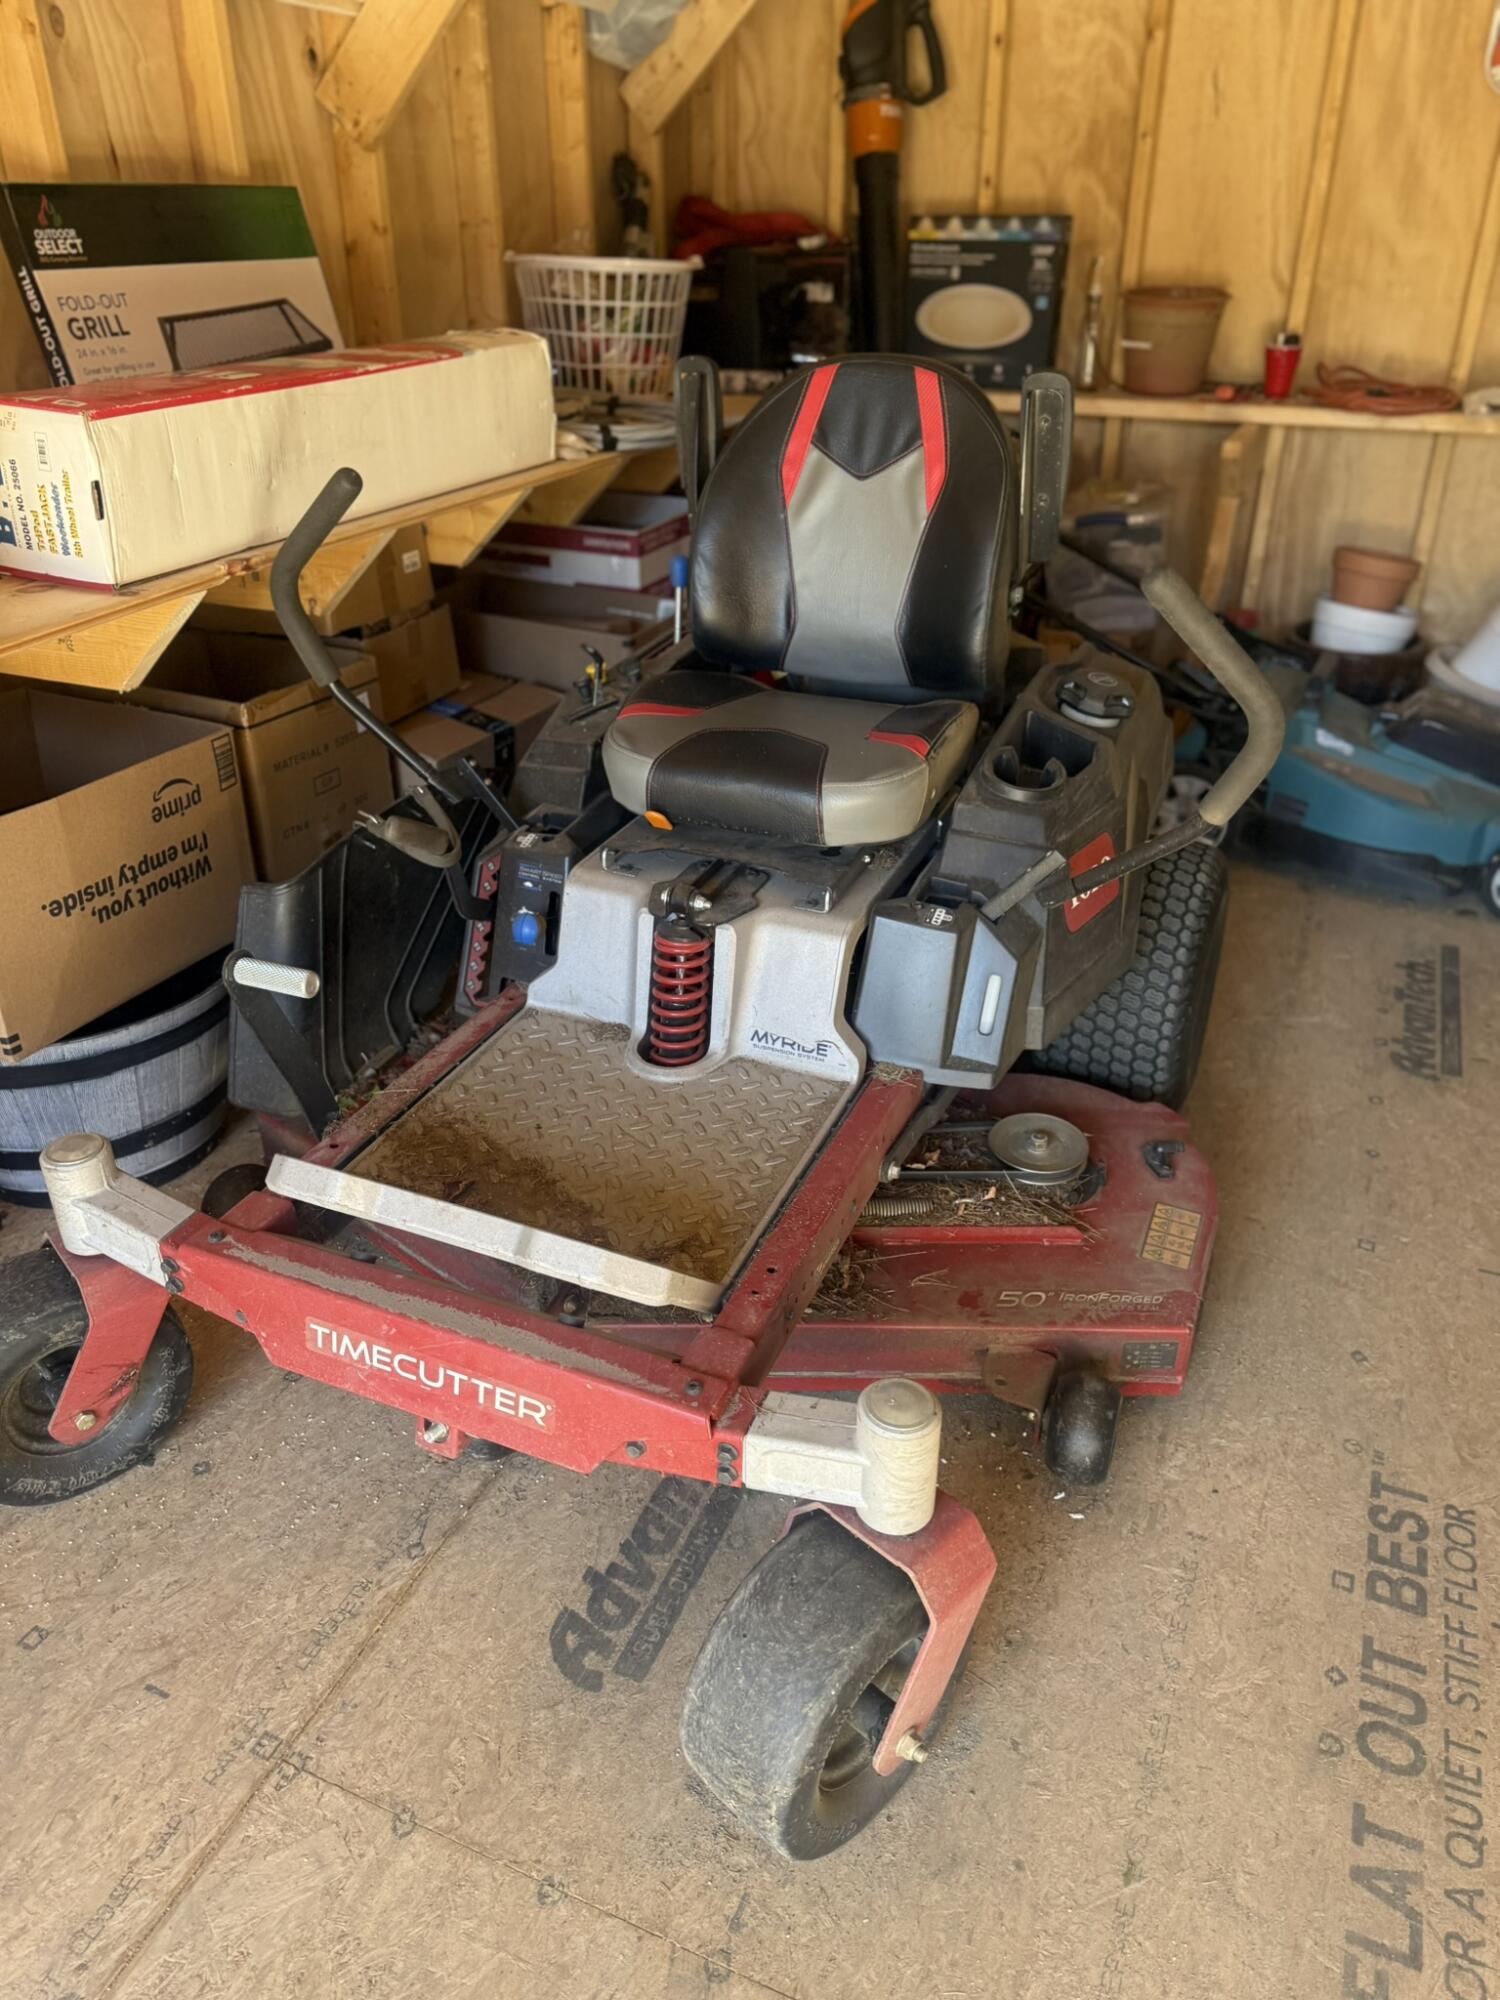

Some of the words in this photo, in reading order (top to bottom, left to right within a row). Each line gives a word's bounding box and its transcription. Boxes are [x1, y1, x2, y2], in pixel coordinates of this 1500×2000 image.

[34, 228, 77, 240] OUTDOOR
[35, 239, 83, 255] SELECT
[18, 266, 41, 314] GRILL
[57, 293, 129, 312] FOLD-OUT
[68, 314, 131, 341] GRILL
[36, 316, 70, 387] OLD-OUT
[8, 458, 21, 492] 25066
[15, 491, 26, 512] NO.
[19, 514, 34, 551] MODEL
[151, 783, 202, 823] prime
[181, 831, 209, 857] I'm
[118, 844, 178, 888] empty
[138, 855, 213, 907] Without
[41, 875, 116, 917] inside.
[91, 888, 135, 924] you,
[750, 1029, 829, 1058] MYRIDE
[752, 1043, 796, 1057] SUSPENSION
[797, 1052, 825, 1063] SYSTEM
[309, 1323, 547, 1427] TIMECUTTER
[1443, 1503, 1479, 1612] FLOOR
[1444, 1614, 1481, 1713] STIFF
[1356, 1634, 1429, 1777] OUT
[1444, 1727, 1489, 1869] QUIET,
[1444, 1888, 1486, 1922] A
